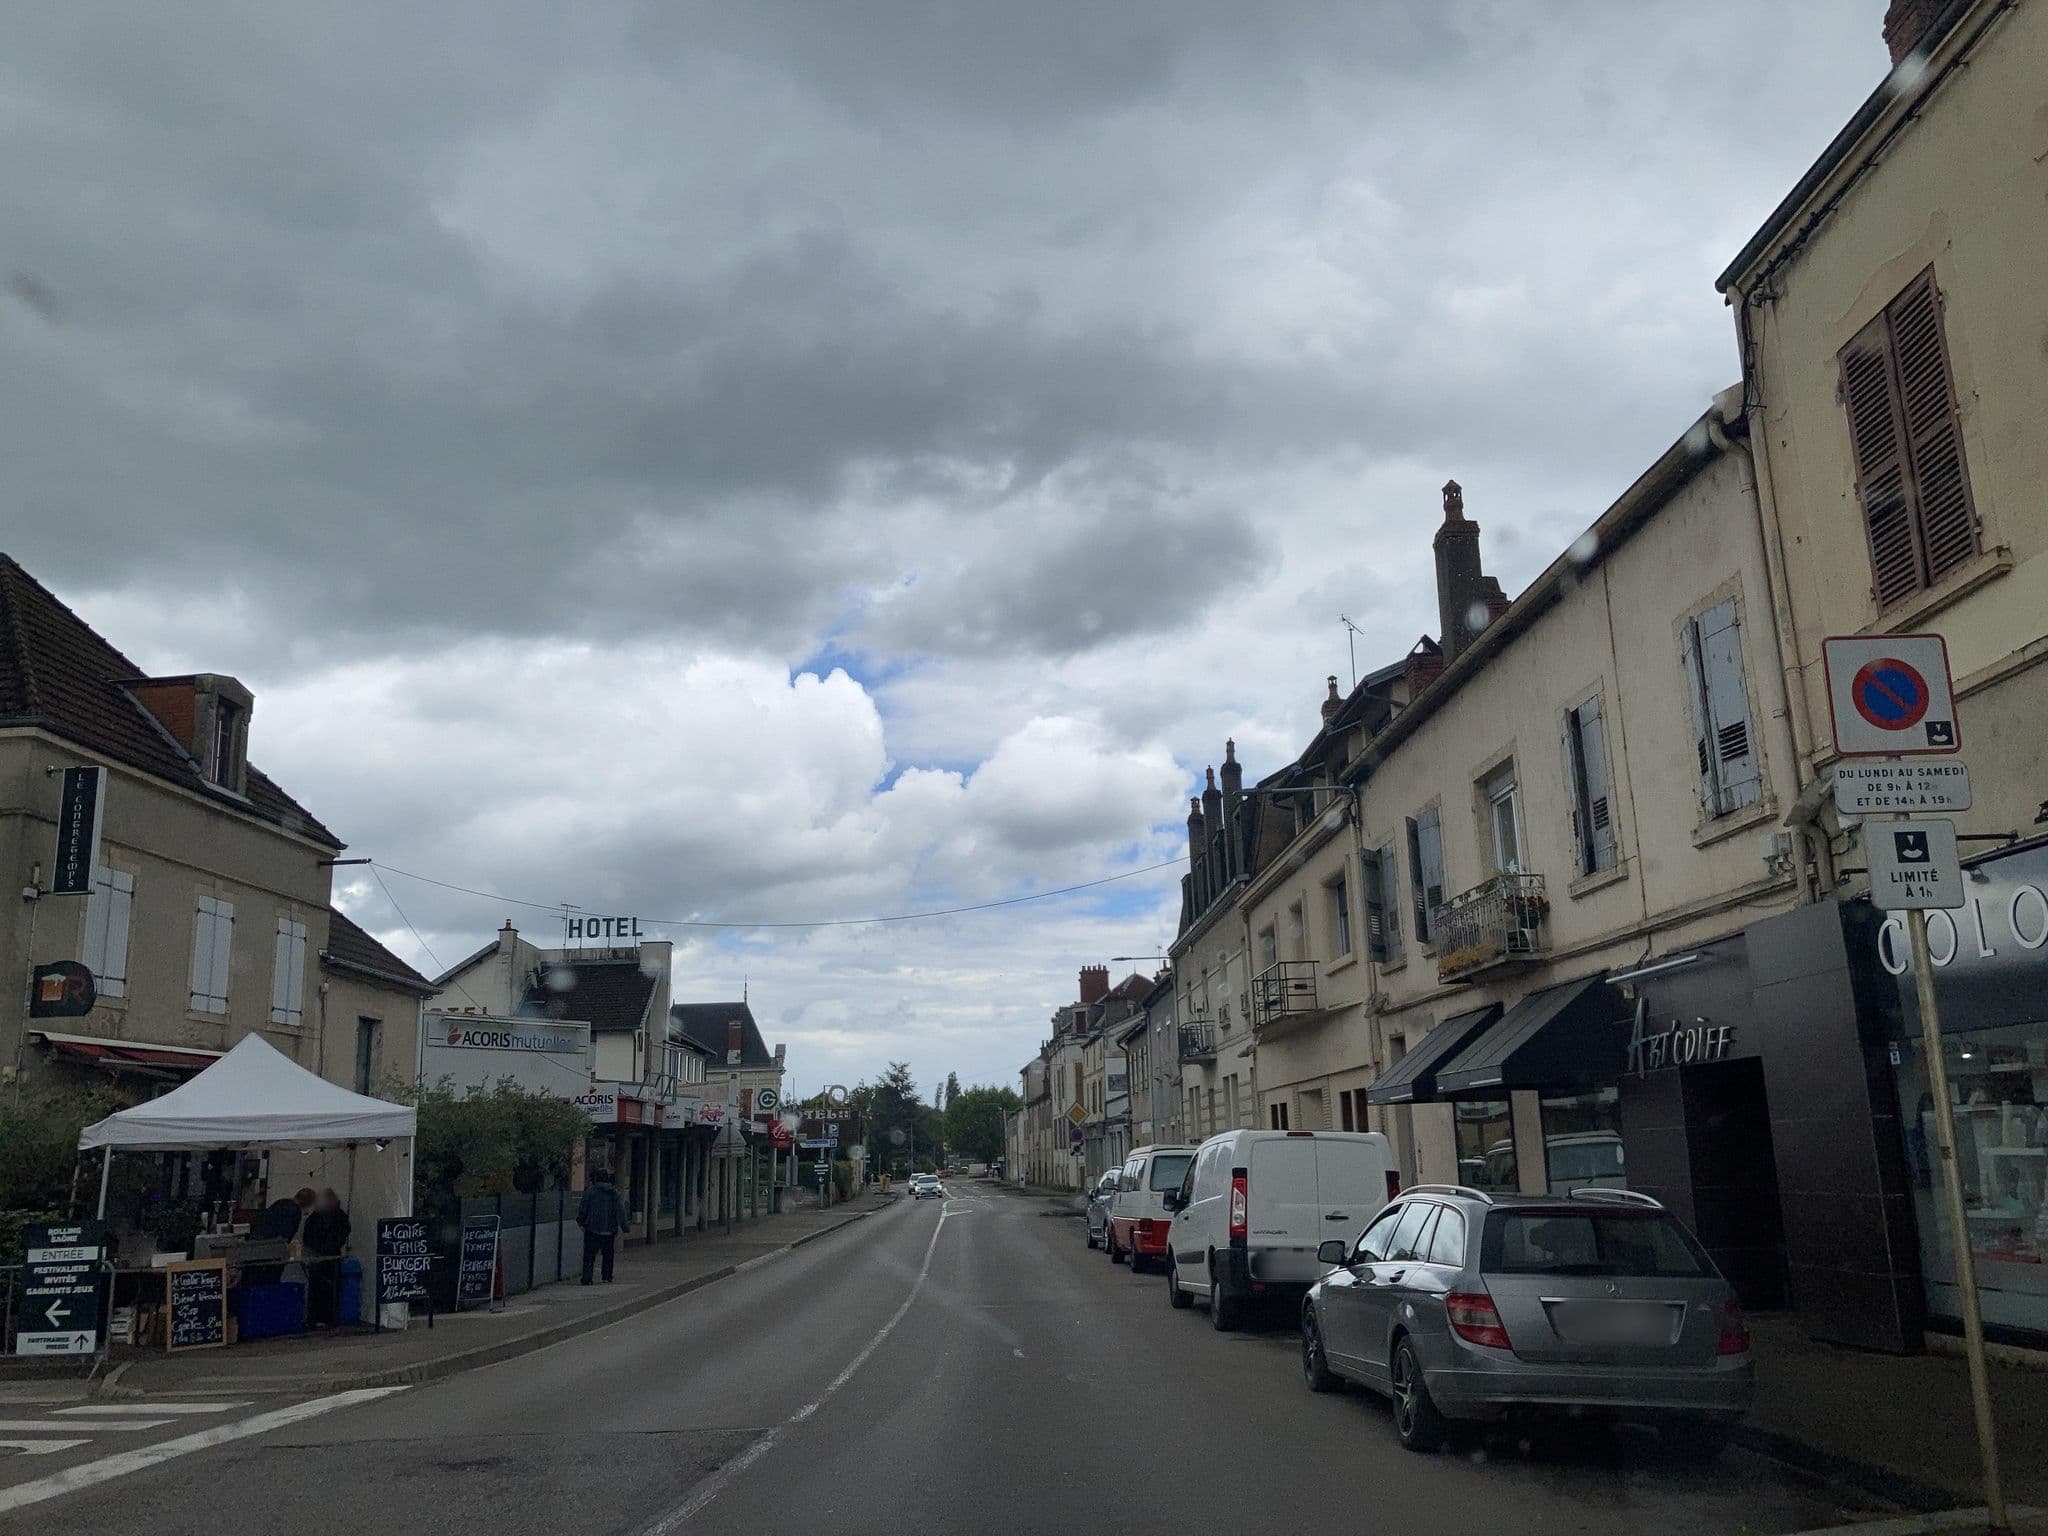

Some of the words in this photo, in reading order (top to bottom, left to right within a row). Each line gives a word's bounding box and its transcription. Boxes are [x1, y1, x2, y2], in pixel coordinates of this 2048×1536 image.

[1839, 769, 1854, 779] DU
[1858, 768, 1893, 778] LUNDI
[1898, 768, 1913, 777] AU
[1917, 766, 1965, 777] SAMEDI
[76, 773, 86, 790] LE
[1867, 782, 1882, 792] DE
[1886, 782, 1901, 791] 9h
[1905, 780, 1913, 791] À
[1918, 782, 1937, 791] 12
[1857, 797, 1870, 807] ET
[1875, 796, 1890, 806] DE
[1895, 796, 1915, 806] 14h
[1920, 794, 1928, 805] À
[1932, 795, 1952, 805] 19h
[1890, 869, 1939, 883] LIMITÉ
[1905, 885, 1914, 898] À
[1919, 886, 1933, 898] 1h
[568, 917, 643, 939] HOTEL
[462, 1031, 511, 1048] ACORIS
[511, 1033, 574, 1050] mutuelle
[572, 1094, 614, 1105] ACORIS
[392, 1239, 428, 1255] TEMPS
[33, 1264, 91, 1274] FESTIVALIERS
[381, 1256, 431, 1273] BURGER
[43, 1274, 78, 1284] INVITÉS
[25, 1286, 72, 1295] GAGNANTS
[72, 1285, 95, 1294] JEUX
